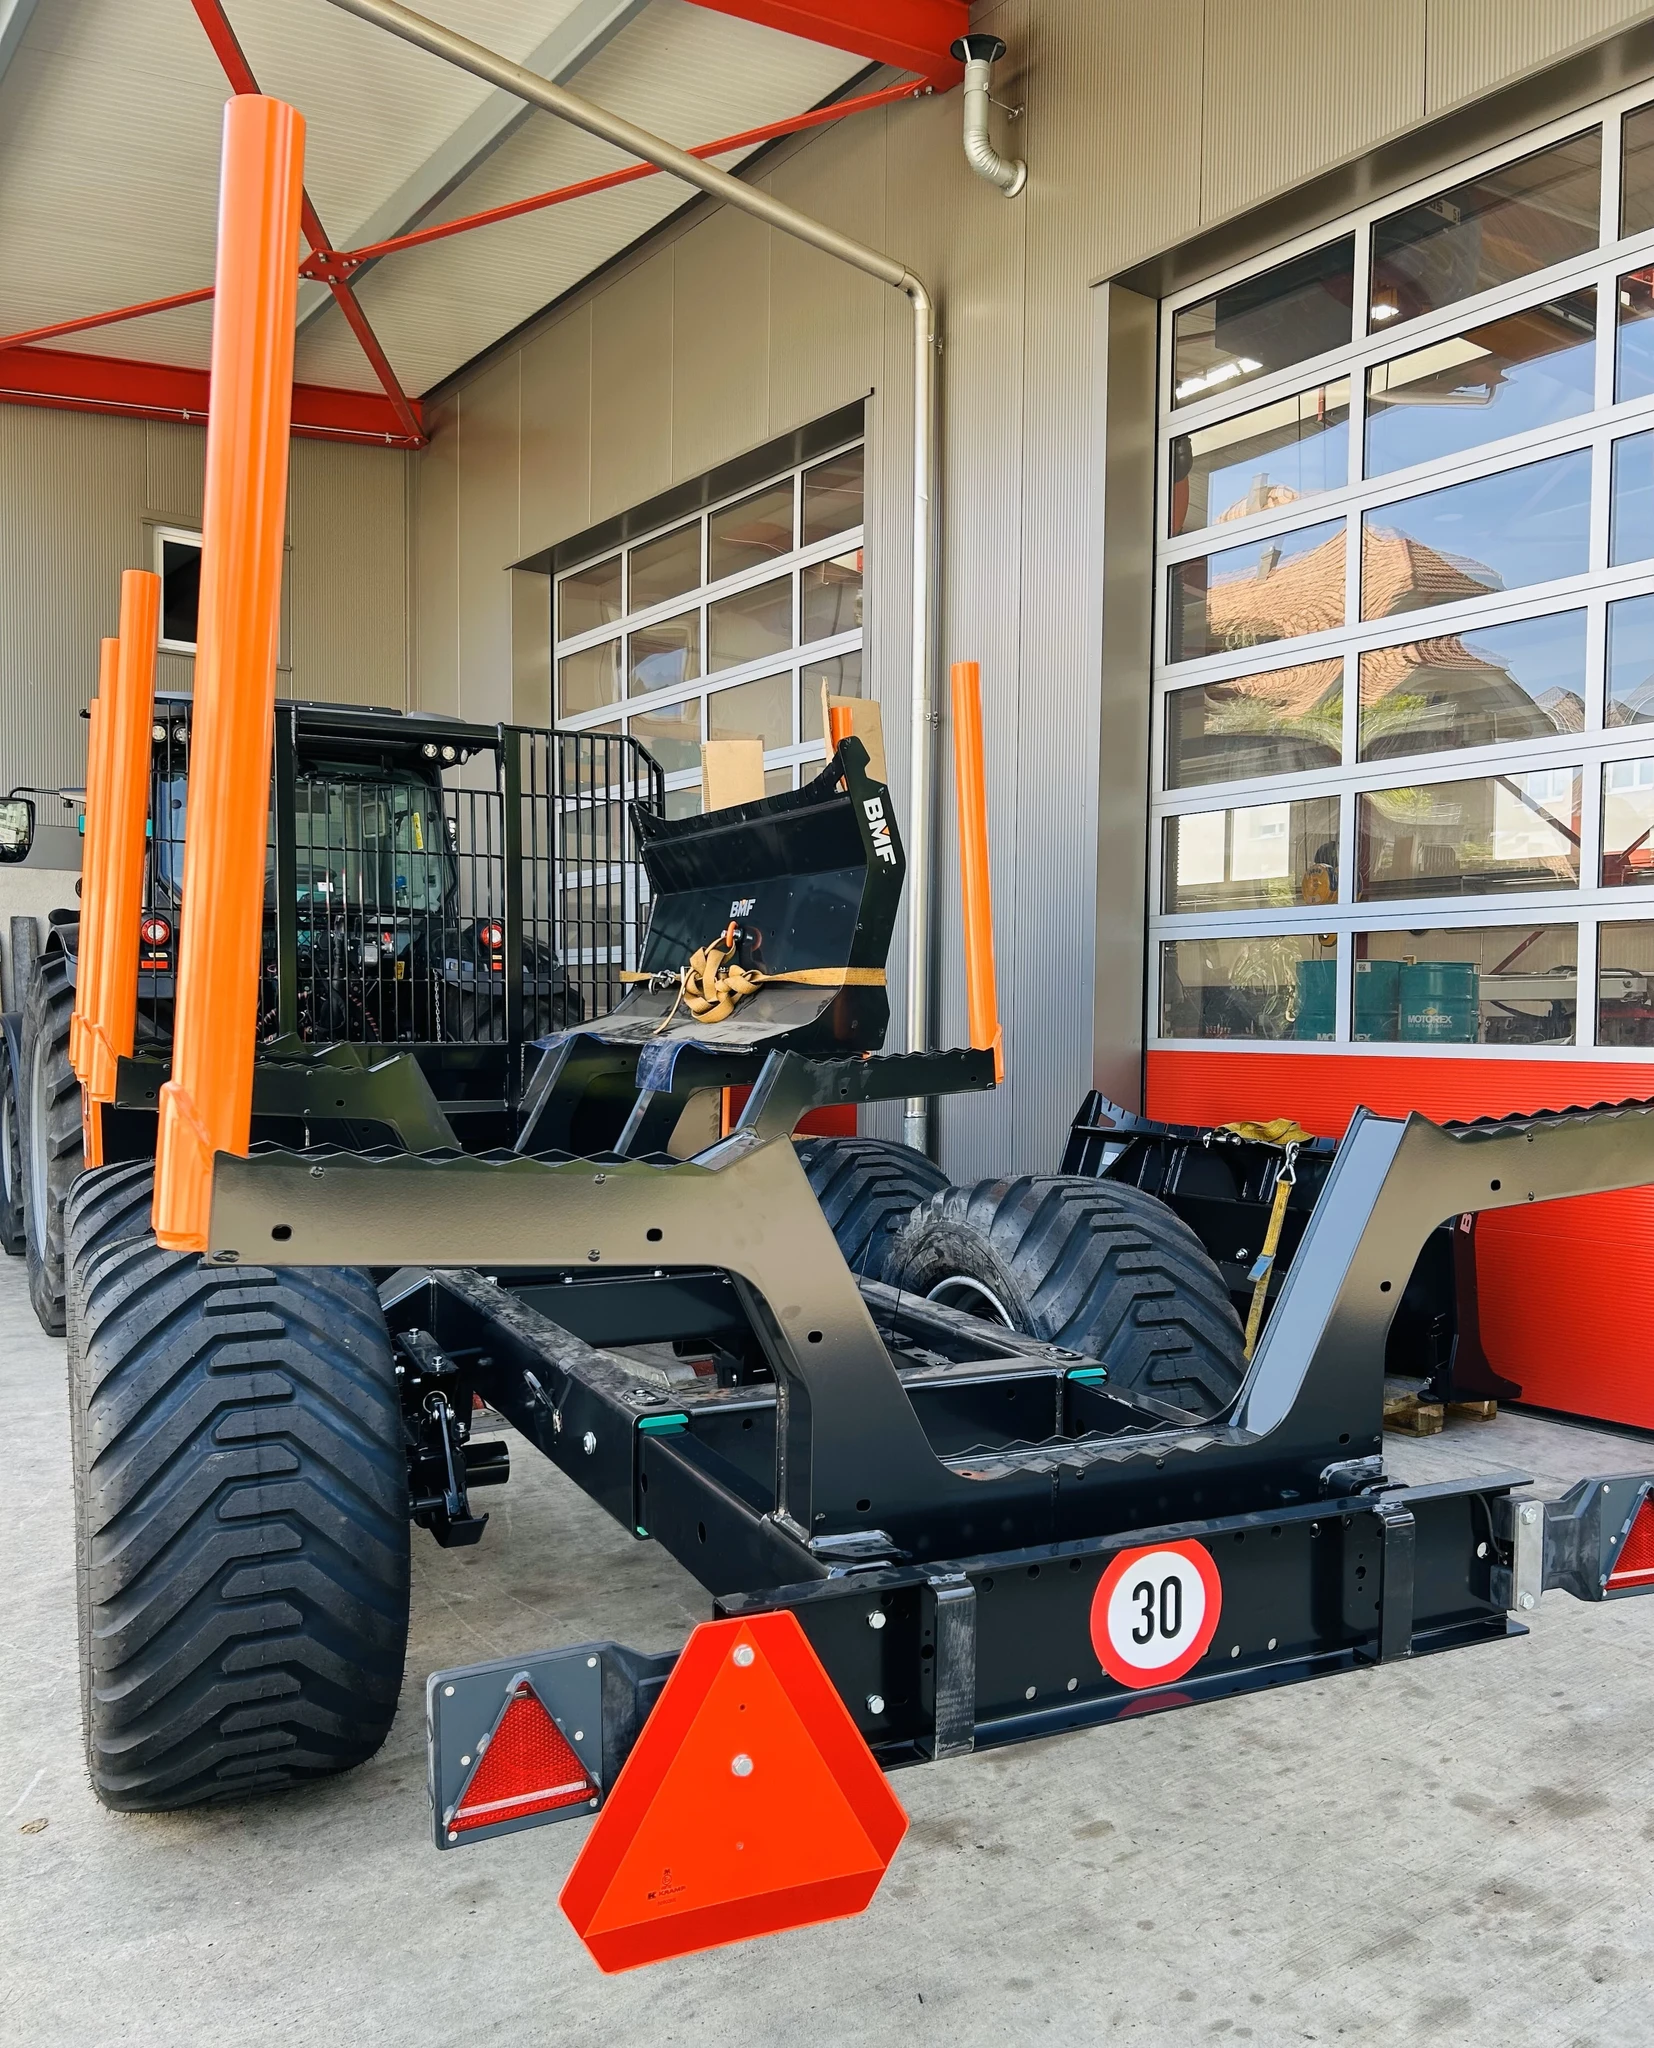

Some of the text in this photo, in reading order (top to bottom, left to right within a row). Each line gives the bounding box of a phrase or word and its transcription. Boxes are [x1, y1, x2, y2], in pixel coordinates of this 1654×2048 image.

[863, 796, 897, 865] BMF
[730, 898, 756, 917] BMF
[1407, 1014, 1453, 1024] MOTOREX
[1132, 1575, 1182, 1644] 30
